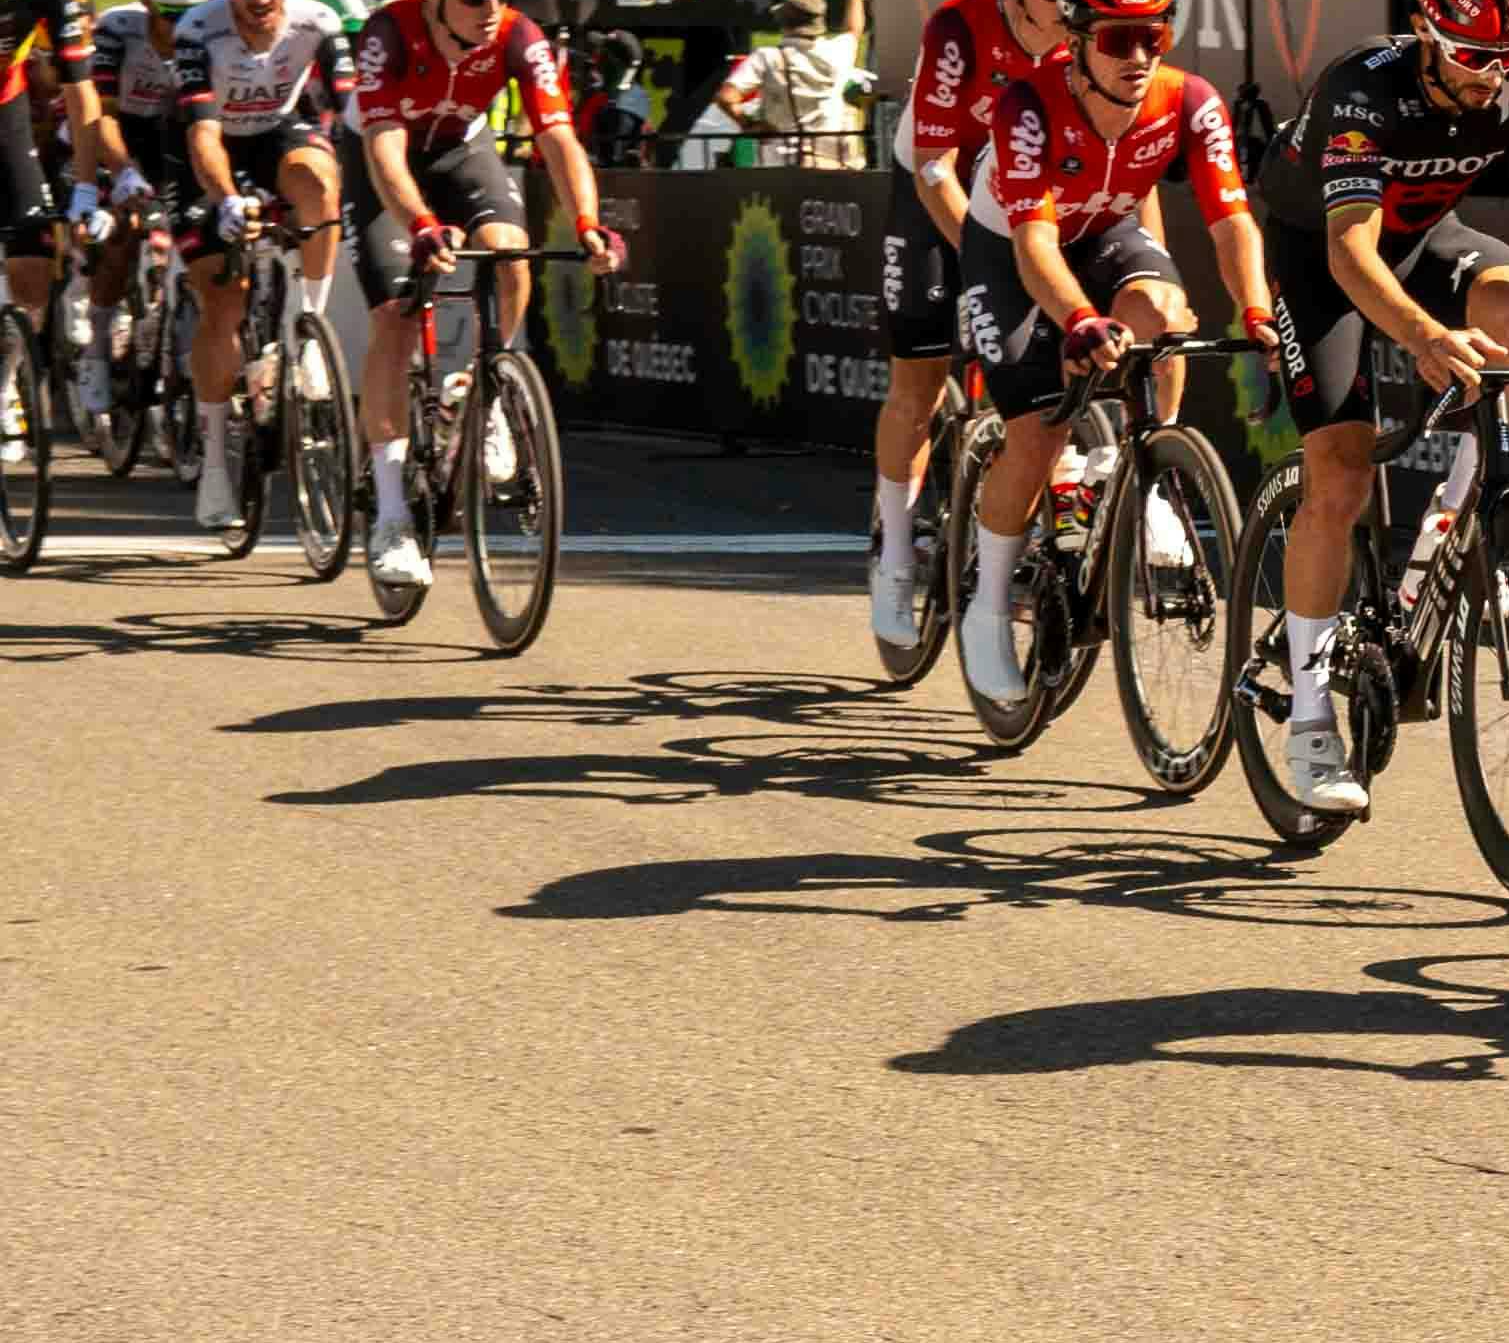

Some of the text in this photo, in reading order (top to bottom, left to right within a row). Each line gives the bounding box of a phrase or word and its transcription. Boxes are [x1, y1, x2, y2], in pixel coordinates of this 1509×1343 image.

[228, 83, 292, 102] UAE
[925, 40, 965, 109] lotto
[1007, 110, 1045, 180] lotto
[1135, 132, 1176, 162] CAPS
[1190, 97, 1234, 172] lotto
[1332, 104, 1385, 127] MSC
[883, 236, 906, 311] lotto
[966, 284, 1003, 363] lotto
[1274, 298, 1306, 378] TUDOR
[805, 353, 837, 395] DE
